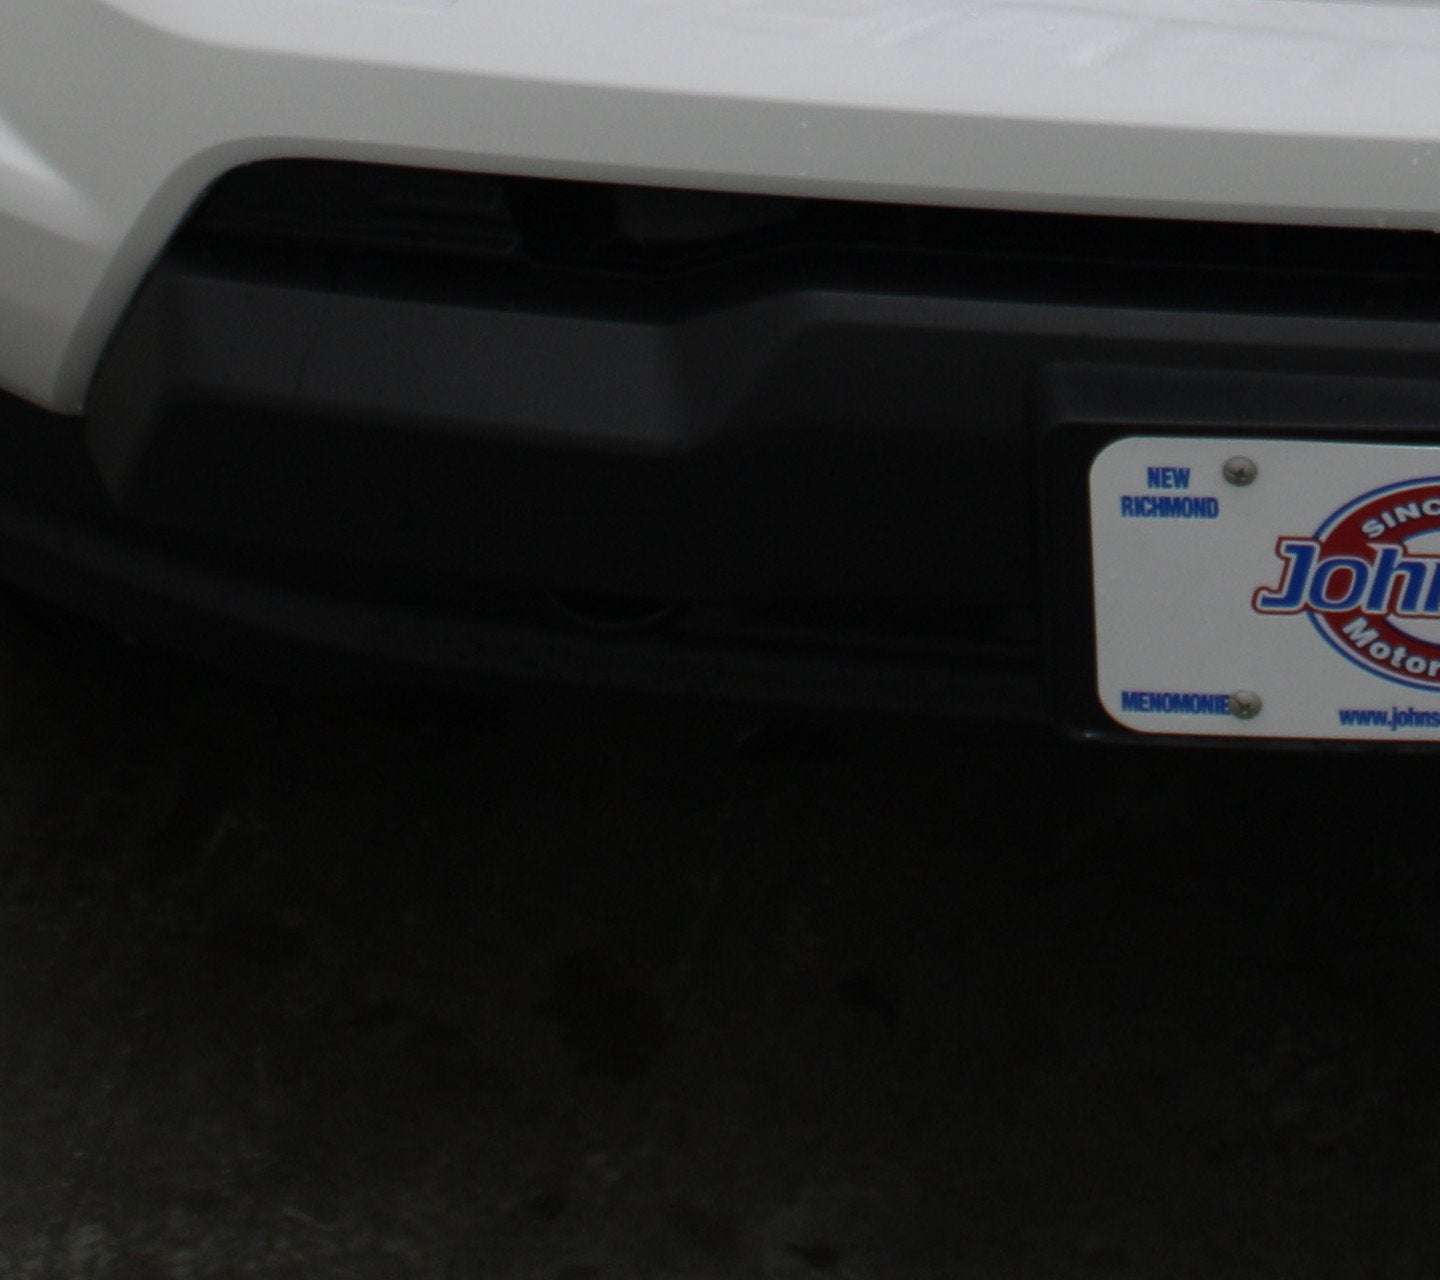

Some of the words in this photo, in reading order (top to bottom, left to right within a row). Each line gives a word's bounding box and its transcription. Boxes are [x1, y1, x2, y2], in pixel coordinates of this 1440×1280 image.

[1147, 467, 1191, 489] NEW
[1121, 496, 1219, 519] RICHMOND
[1122, 692, 1232, 716] MENOMONIE
